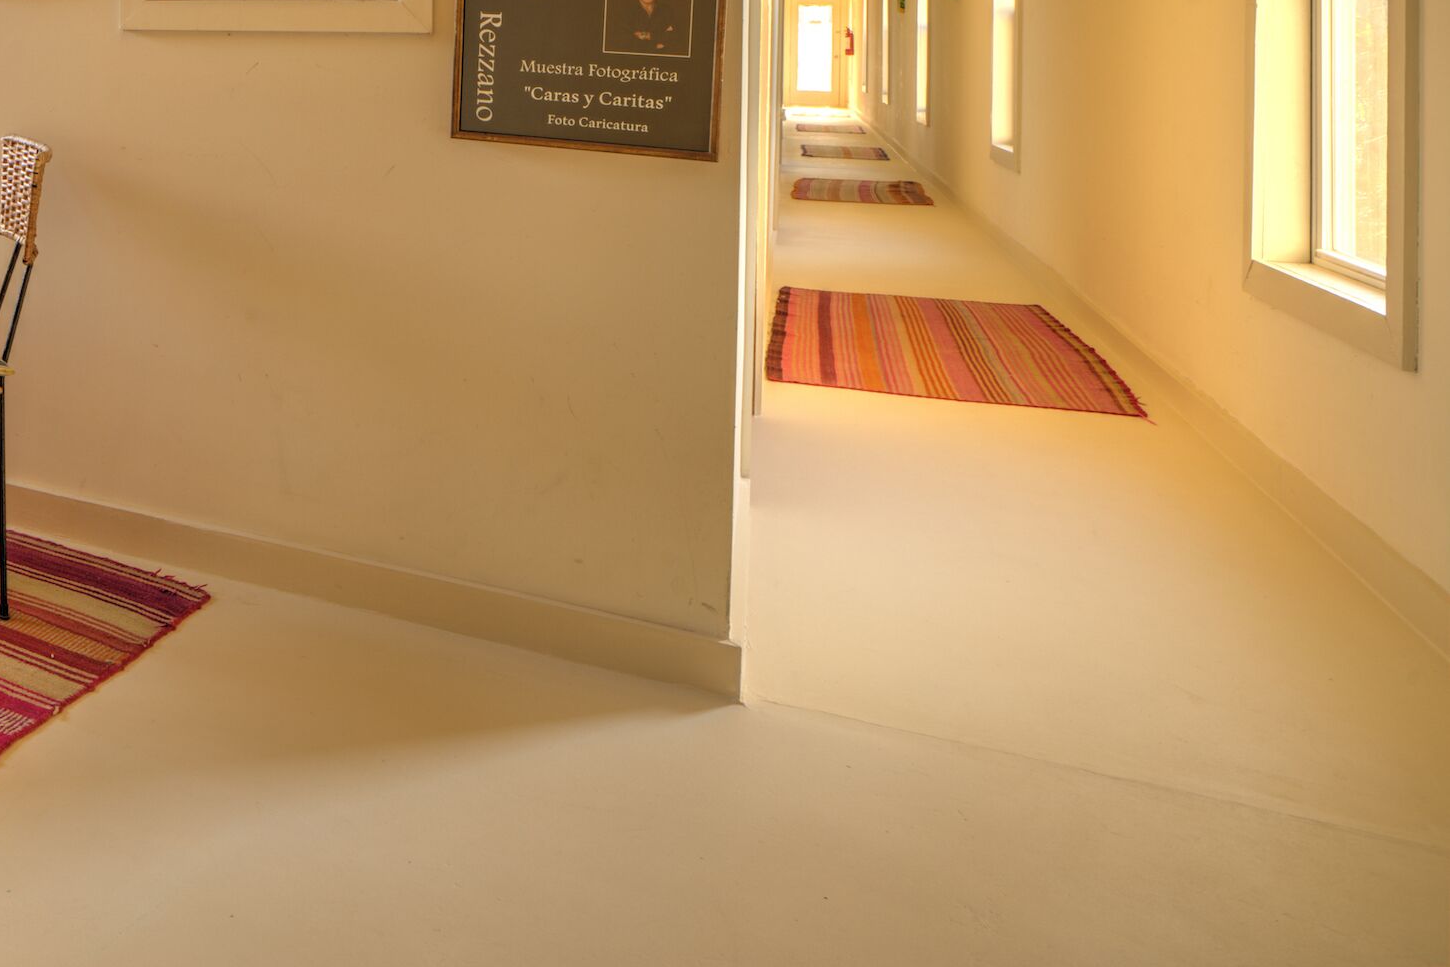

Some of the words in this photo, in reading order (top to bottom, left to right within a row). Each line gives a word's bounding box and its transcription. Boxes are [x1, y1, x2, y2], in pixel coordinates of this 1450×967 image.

[476, 11, 503, 122] Rezzano
[519, 59, 583, 76] Muestra
[588, 63, 679, 83] Fotográfica
[524, 85, 580, 104] "Caras
[582, 94, 595, 109] y
[599, 91, 673, 110] Caritas"
[547, 114, 576, 127] Foto
[578, 116, 649, 133] Caricatura
